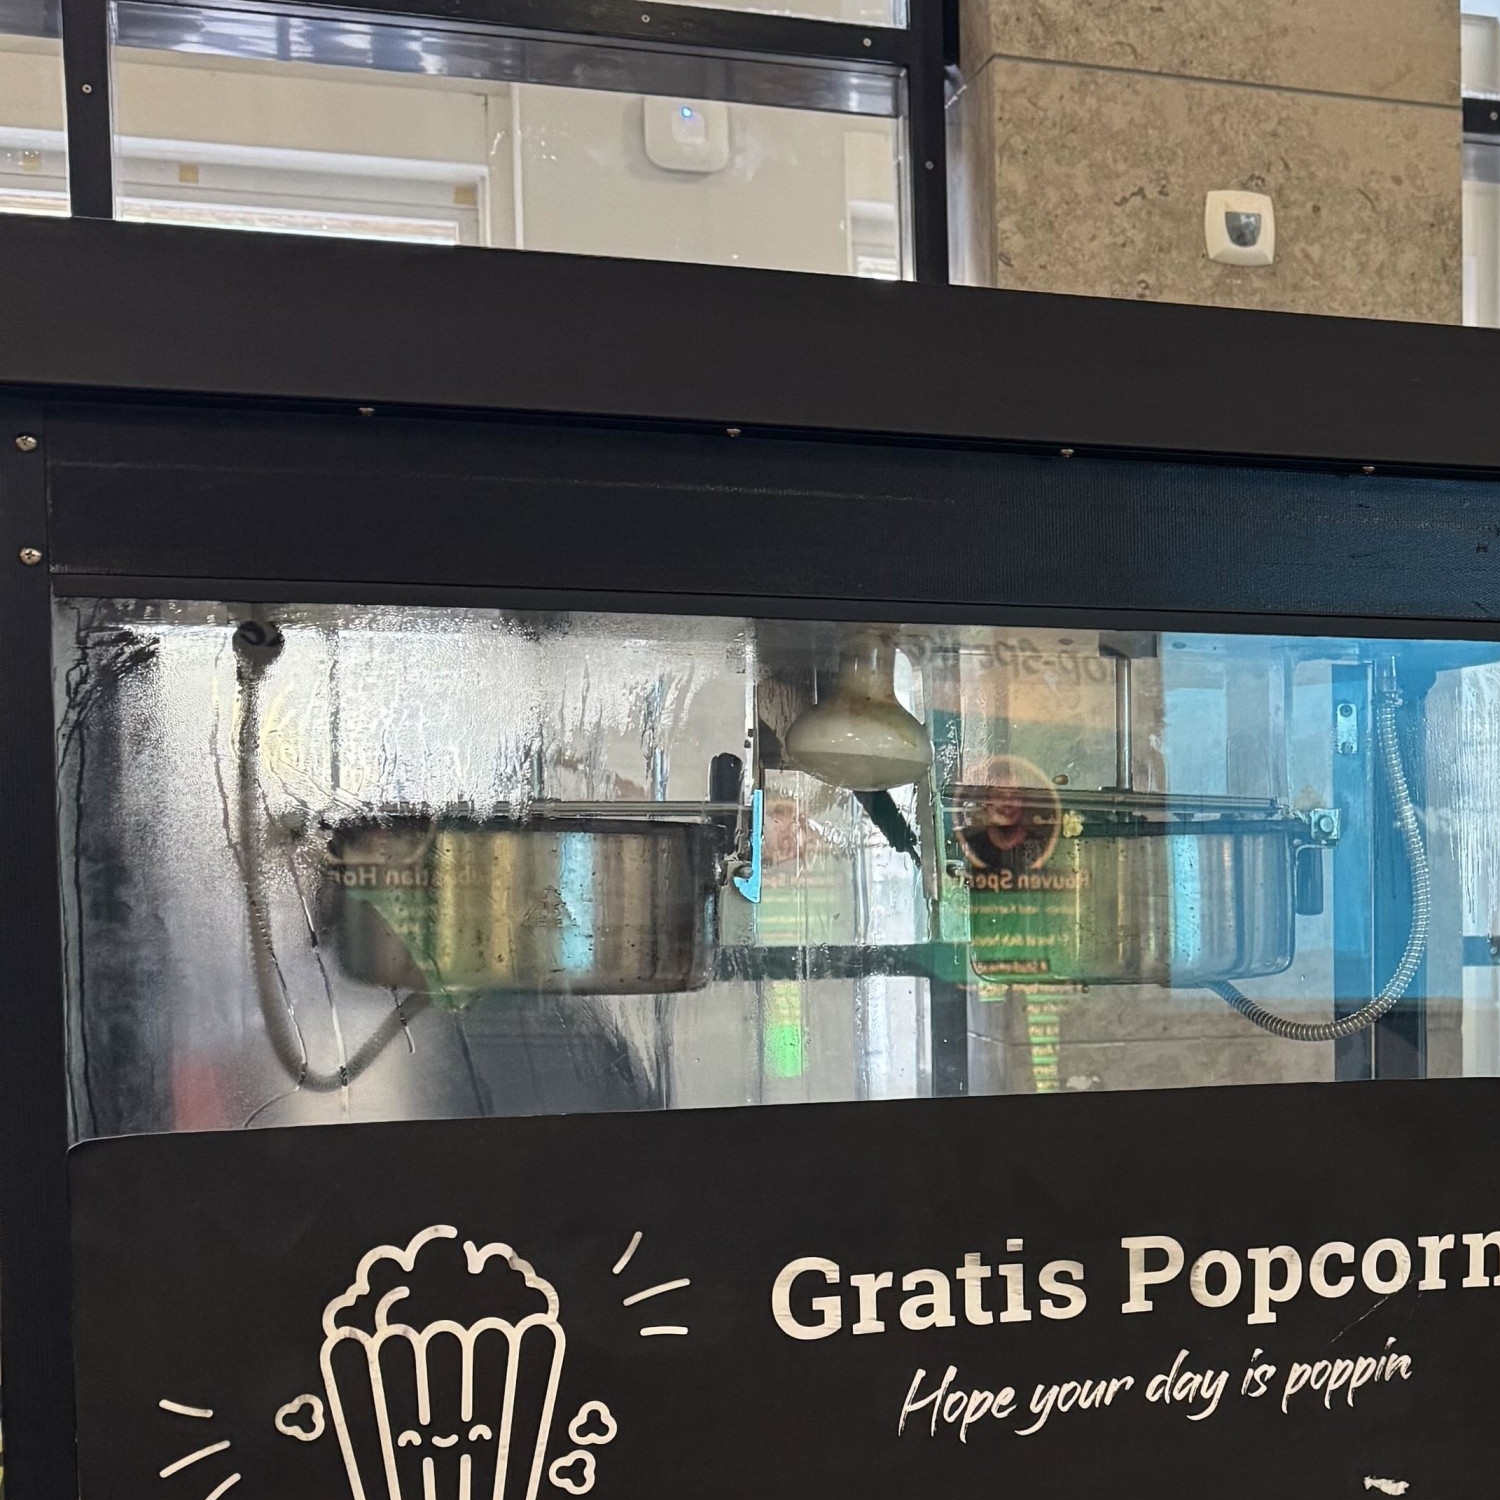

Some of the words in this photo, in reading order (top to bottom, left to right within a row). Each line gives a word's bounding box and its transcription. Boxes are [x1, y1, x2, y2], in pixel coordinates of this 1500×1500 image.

[772, 1238, 1087, 1340] Gratis
[898, 1365, 1017, 1444] Hope
[1014, 1376, 1135, 1436] your
[1146, 1348, 1229, 1421] day
[1240, 1347, 1277, 1398] is
[1281, 1336, 1412, 1414] poppin
